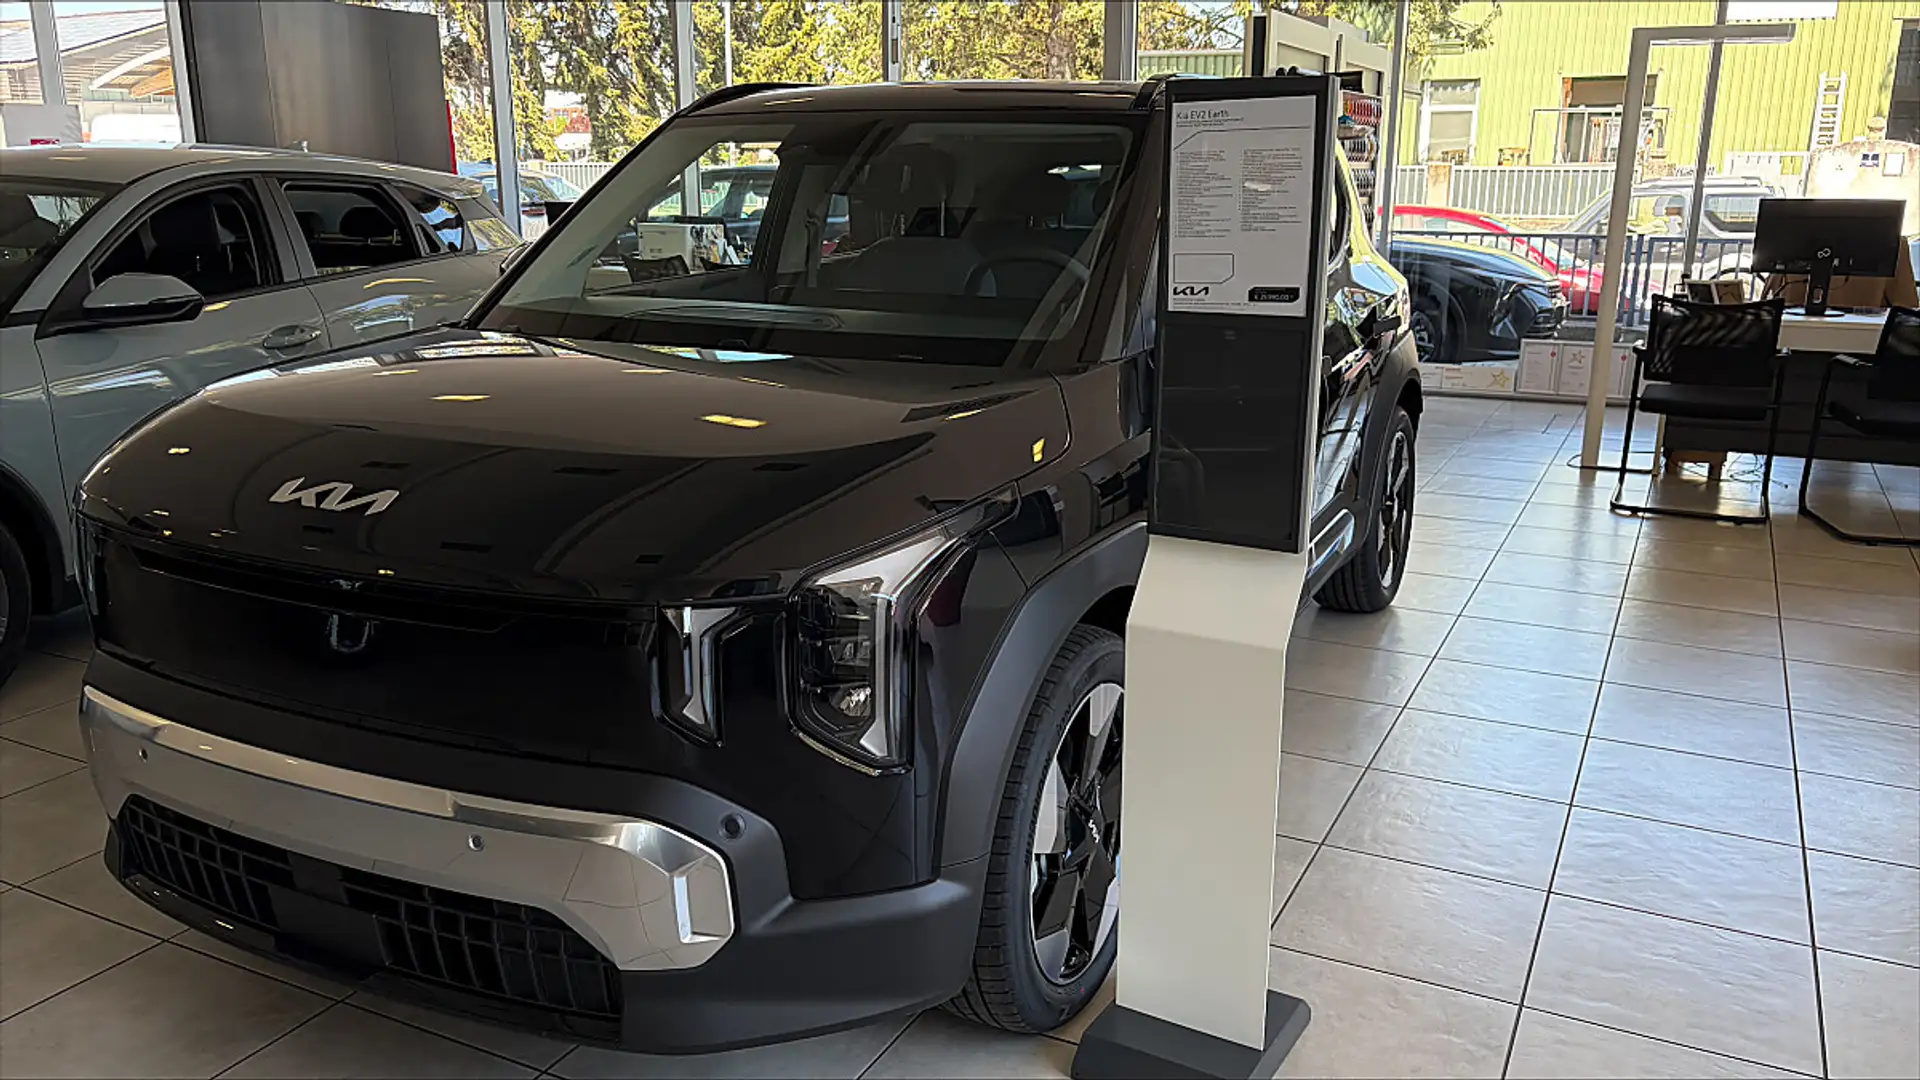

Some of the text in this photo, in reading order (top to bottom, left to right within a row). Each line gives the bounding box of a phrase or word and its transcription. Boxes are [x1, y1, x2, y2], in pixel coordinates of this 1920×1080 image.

[1191, 110, 1206, 119] EV2
[1173, 286, 1210, 296] KIA
[269, 476, 399, 515] KIA
